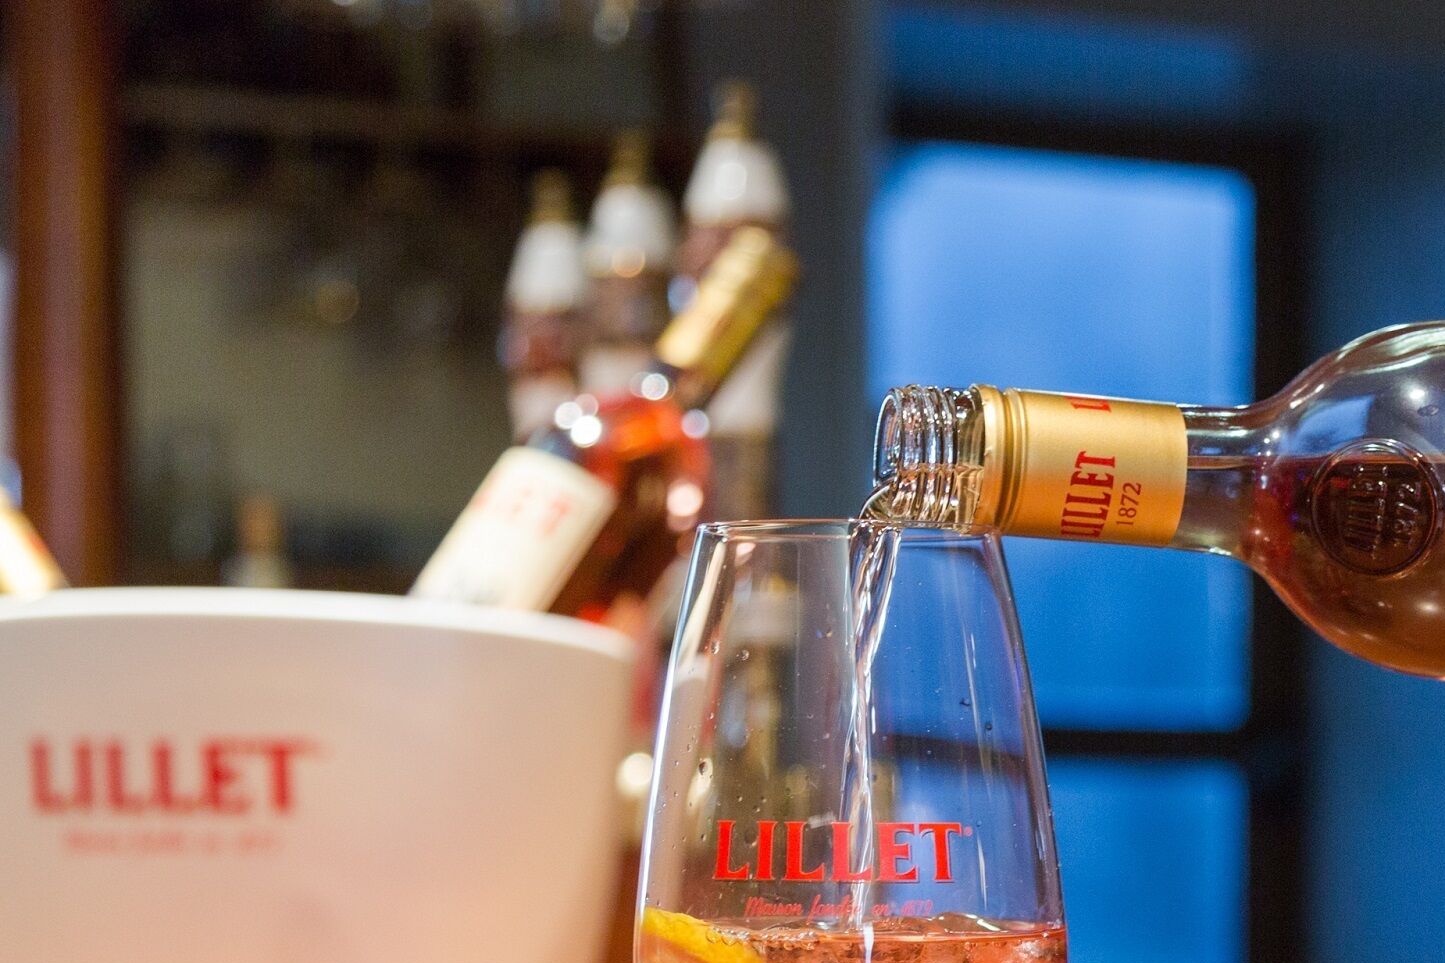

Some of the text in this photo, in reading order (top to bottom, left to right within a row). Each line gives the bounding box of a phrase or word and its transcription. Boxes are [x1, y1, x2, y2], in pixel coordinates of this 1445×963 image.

[1060, 450, 1116, 539] LILLET
[1115, 482, 1142, 526] 1872
[28, 737, 318, 815] LILLET
[712, 819, 962, 884] LILLET
